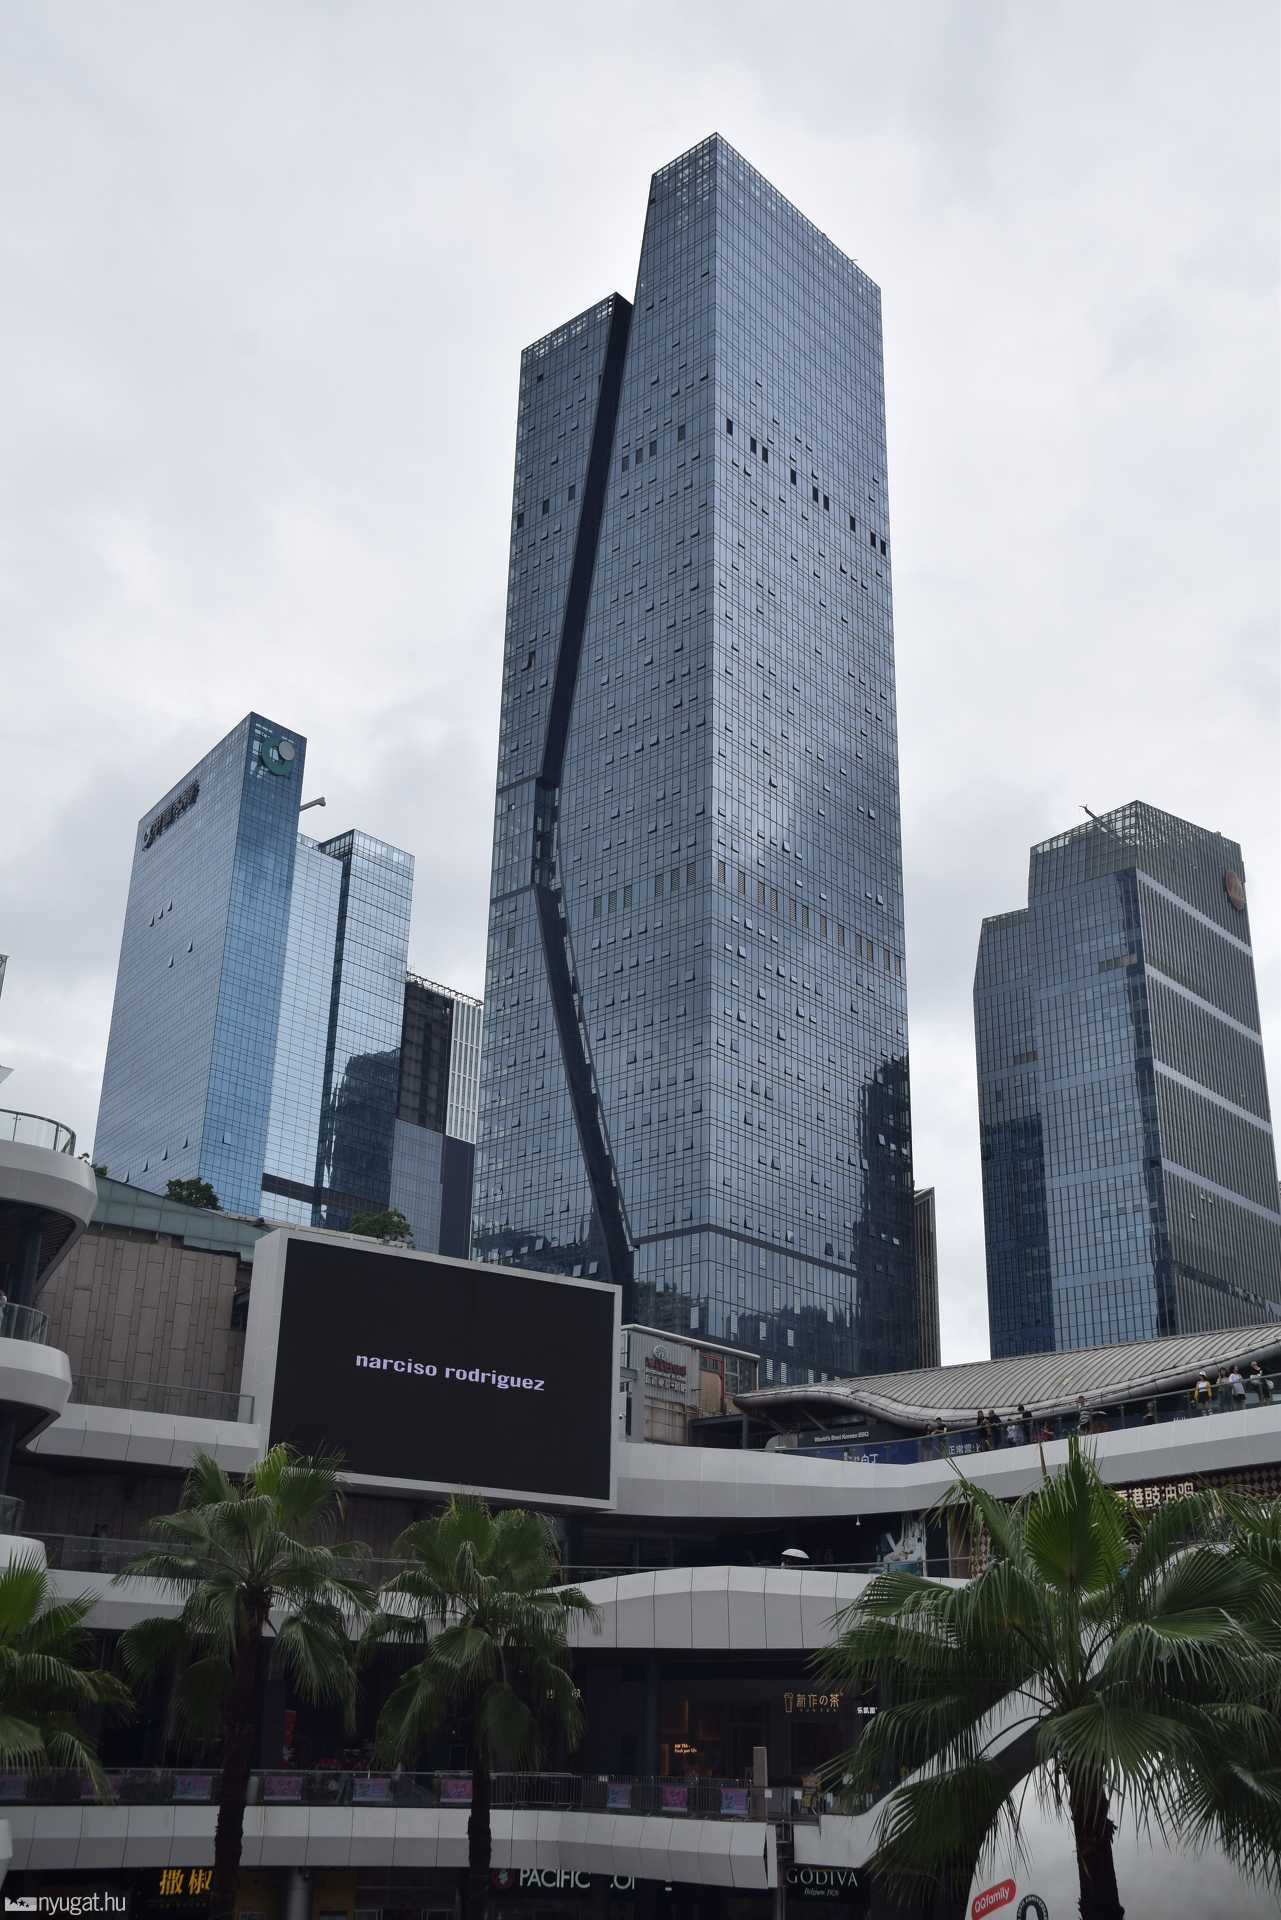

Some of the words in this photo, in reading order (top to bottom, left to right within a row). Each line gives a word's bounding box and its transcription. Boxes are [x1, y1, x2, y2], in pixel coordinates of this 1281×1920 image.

[355, 1354, 438, 1377] narciso
[445, 1366, 545, 1392] rodriguez
[519, 1868, 592, 1889] PACIFIC
[786, 1867, 858, 1888] GODIVA
[974, 1886, 1010, 1913] QQfamily
